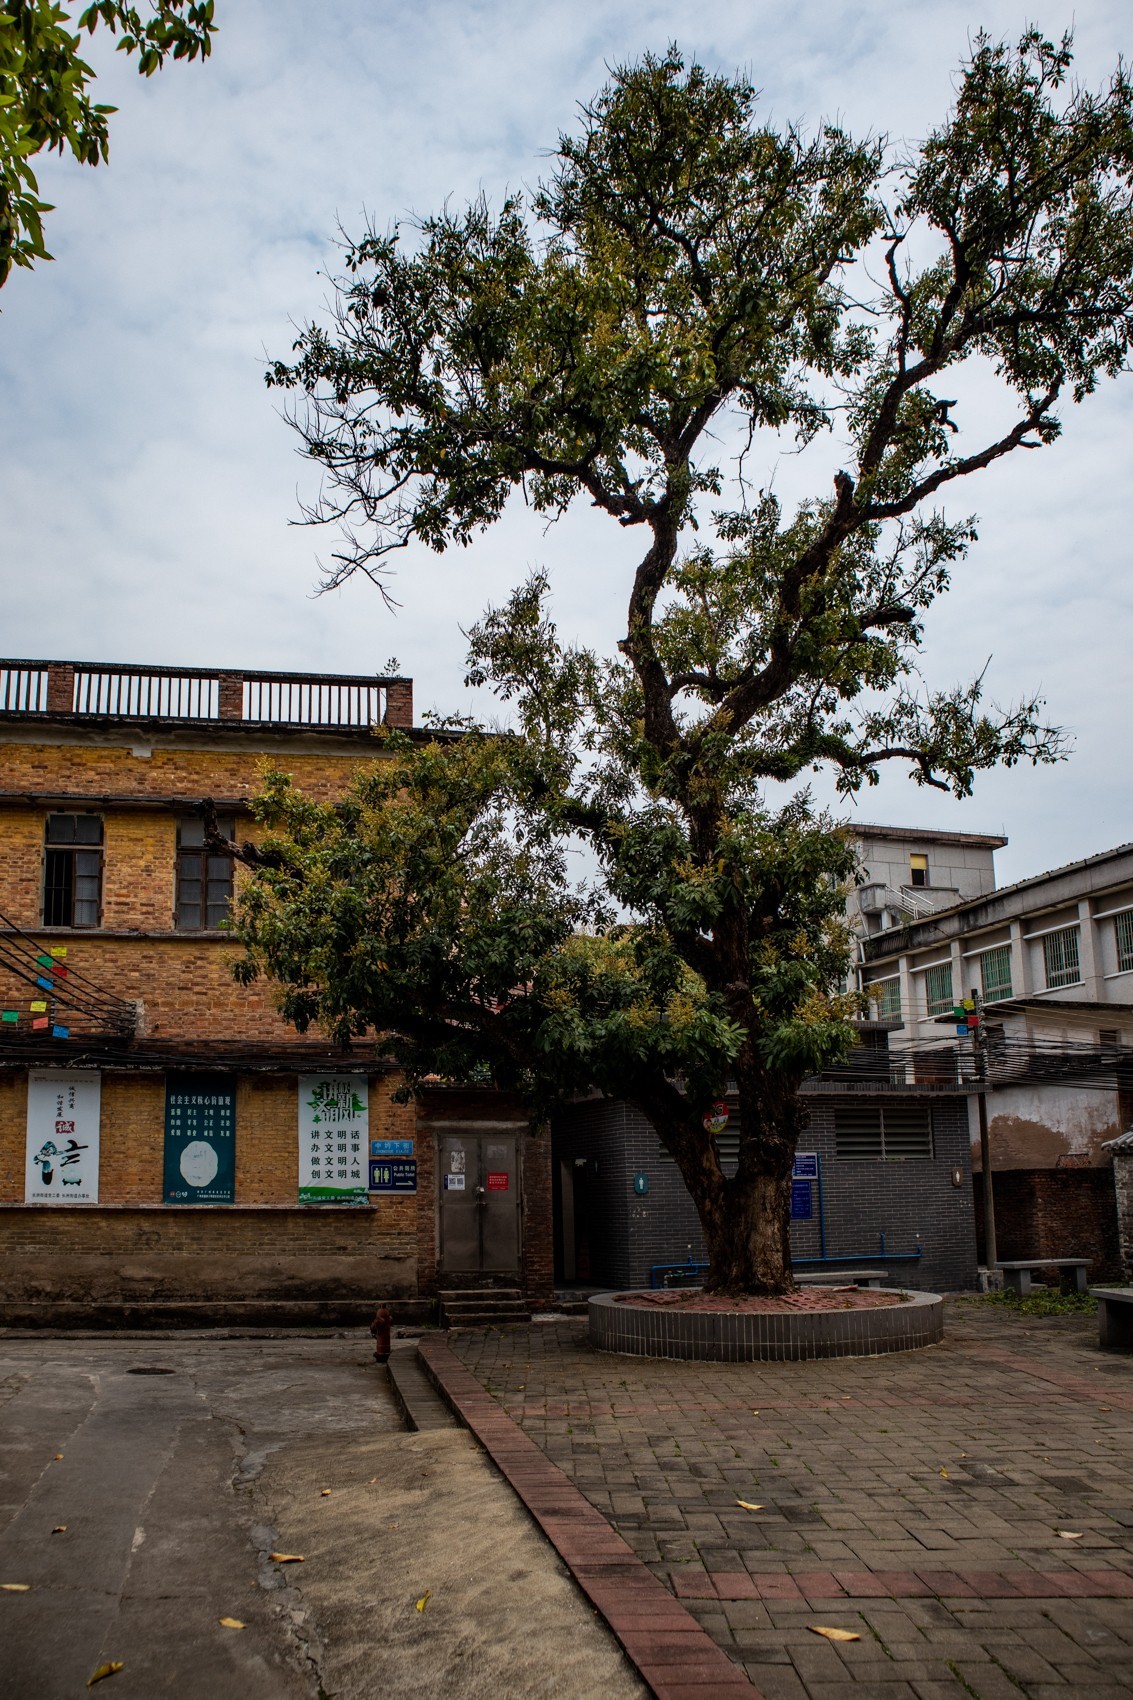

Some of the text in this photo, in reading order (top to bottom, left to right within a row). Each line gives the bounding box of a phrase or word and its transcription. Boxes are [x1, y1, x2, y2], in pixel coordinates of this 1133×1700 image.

[170, 1095, 231, 1105] 社会主义核心价值观
[311, 1130, 361, 1140] 讲文明话
[311, 1143, 361, 1153] 办文明事
[311, 1156, 361, 1166] 做文明人
[311, 1169, 361, 1179] 创文明城
